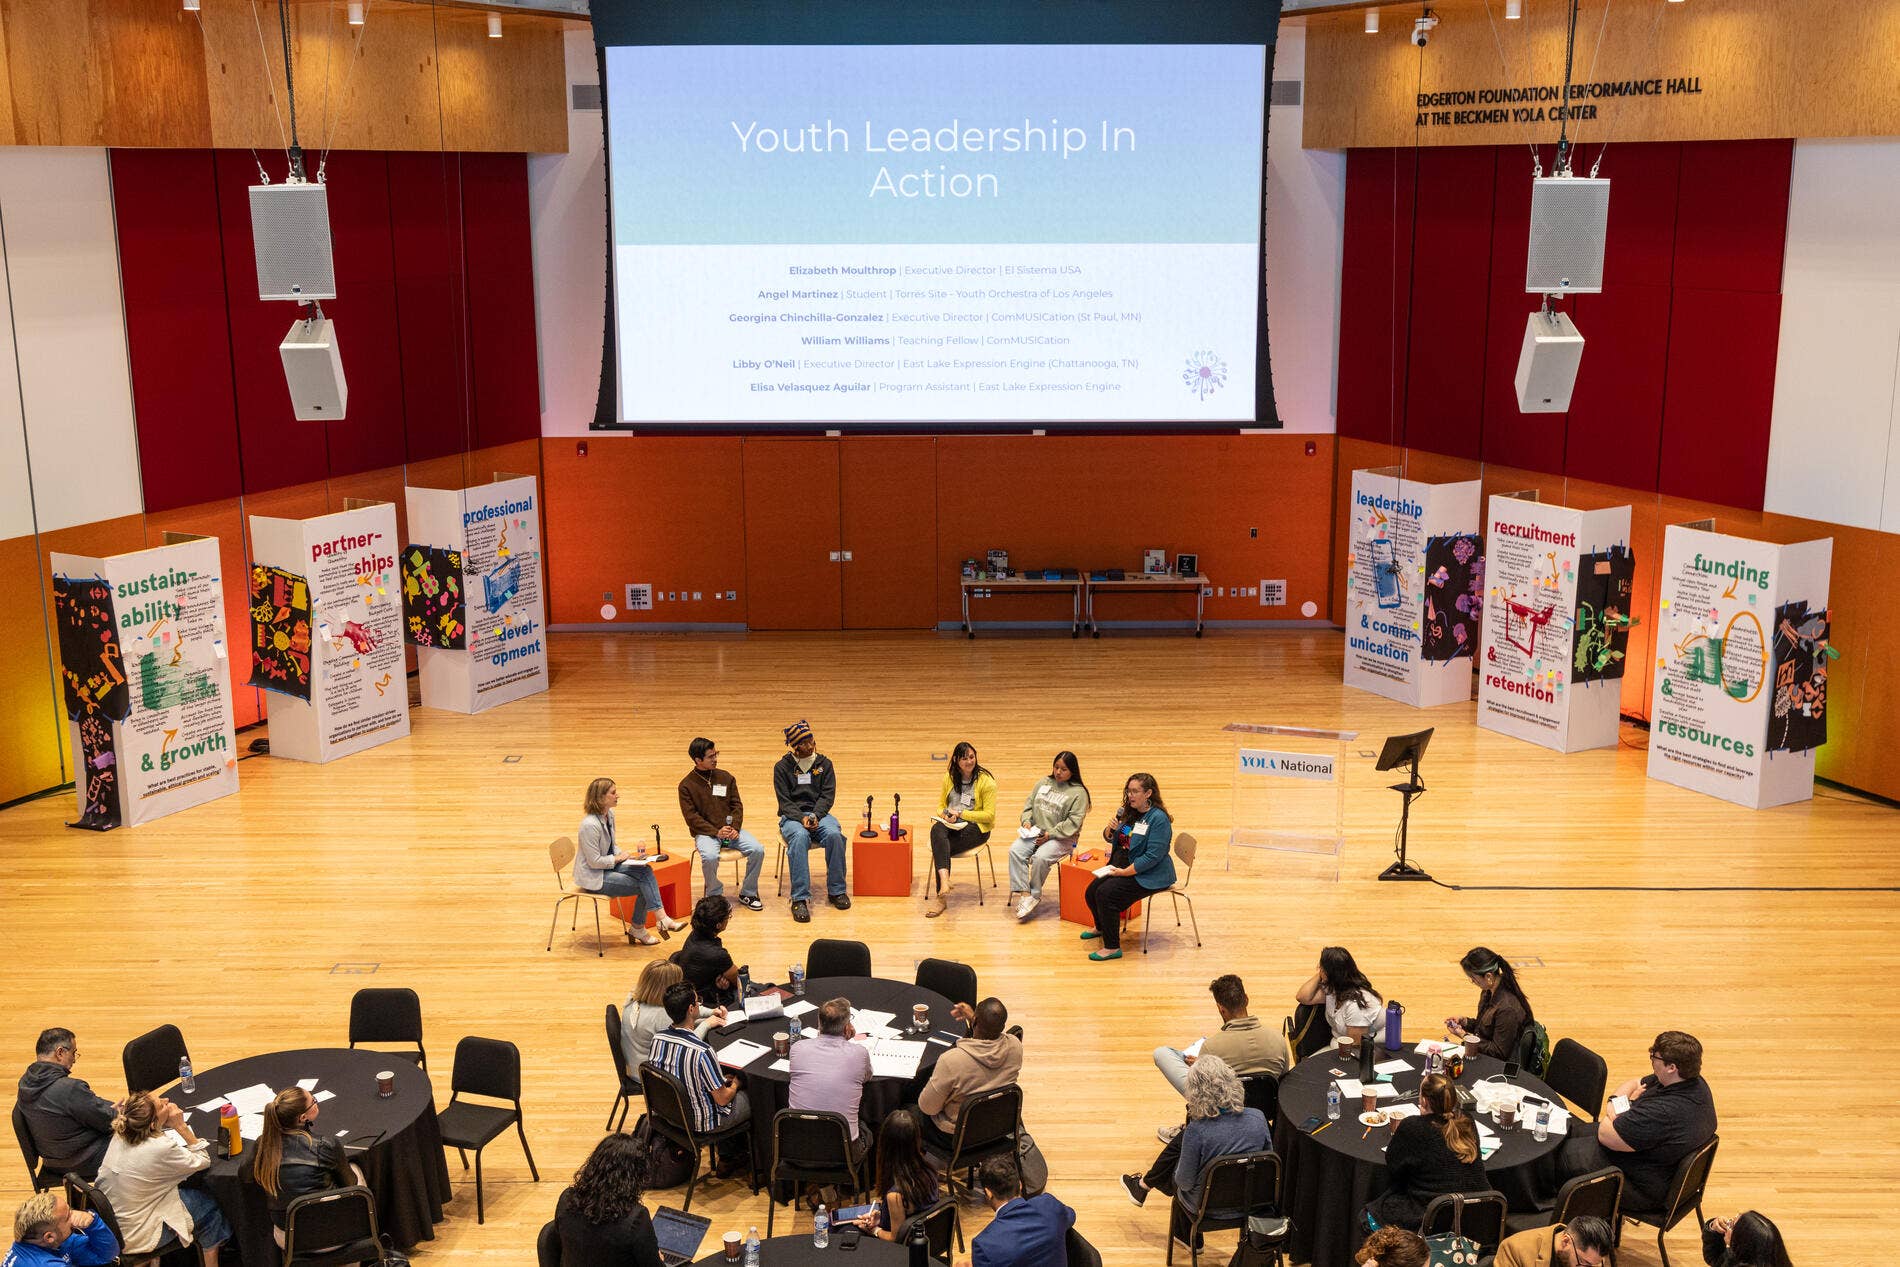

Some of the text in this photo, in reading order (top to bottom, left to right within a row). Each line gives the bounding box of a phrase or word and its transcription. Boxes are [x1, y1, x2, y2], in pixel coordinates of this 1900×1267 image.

[1416, 90, 1476, 107] EDGERTON
[1479, 86, 1559, 104] FOUNDATION
[1666, 77, 1703, 95] HALL
[1415, 105, 1598, 126] AT THE BECKMEN YOLA CENTER
[731, 119, 1136, 160] Youth Leadership In
[869, 165, 999, 199] Action
[789, 265, 1082, 277] Elizabeth Moulthrop Executive Director El Sistema USA
[758, 289, 1113, 301] Angel Martinez Student Torres Site Youth Orchestra of Los Angeles
[729, 313, 777, 324] Georgina
[780, 312, 884, 322] Chinchilla-Gonzalez
[892, 313, 940, 322] Executive
[943, 312, 983, 322] Director
[1121, 312, 1142, 323] MN)
[801, 336, 841, 346] William
[844, 336, 890, 346] Williams
[898, 336, 943, 347] Teaching
[946, 336, 978, 345] Fellow
[733, 360, 761, 371] Libby
[803, 360, 851, 369] Executive
[855, 360, 895, 369] Director
[903, 360, 924, 369] East
[927, 359, 950, 369] Lake
[953, 359, 1007, 370] Expression
[1010, 359, 1046, 370] Engine
[1121, 359, 1139, 370] TN)
[751, 382, 1121, 394] Elisa Velasquez Aguilar Program Assistant East Lake Expression Engine
[463, 496, 533, 528] professional
[1356, 490, 1423, 519] leadership
[312, 531, 383, 562] partner-
[1494, 520, 1576, 548] recruitment
[354, 553, 394, 576] ships
[1694, 553, 1769, 590] funding
[117, 568, 197, 598] sustain-
[121, 600, 182, 628] ability
[1361, 614, 1412, 641] & comm
[498, 620, 539, 642] devel-
[492, 639, 541, 667] opment
[1350, 636, 1409, 663] unication
[1487, 646, 1498, 662] &
[1486, 672, 1554, 704] retention
[1661, 678, 1673, 696] &
[1658, 718, 1754, 758] resources
[141, 733, 227, 773] & growth
[1241, 756, 1332, 774] YOLA National
